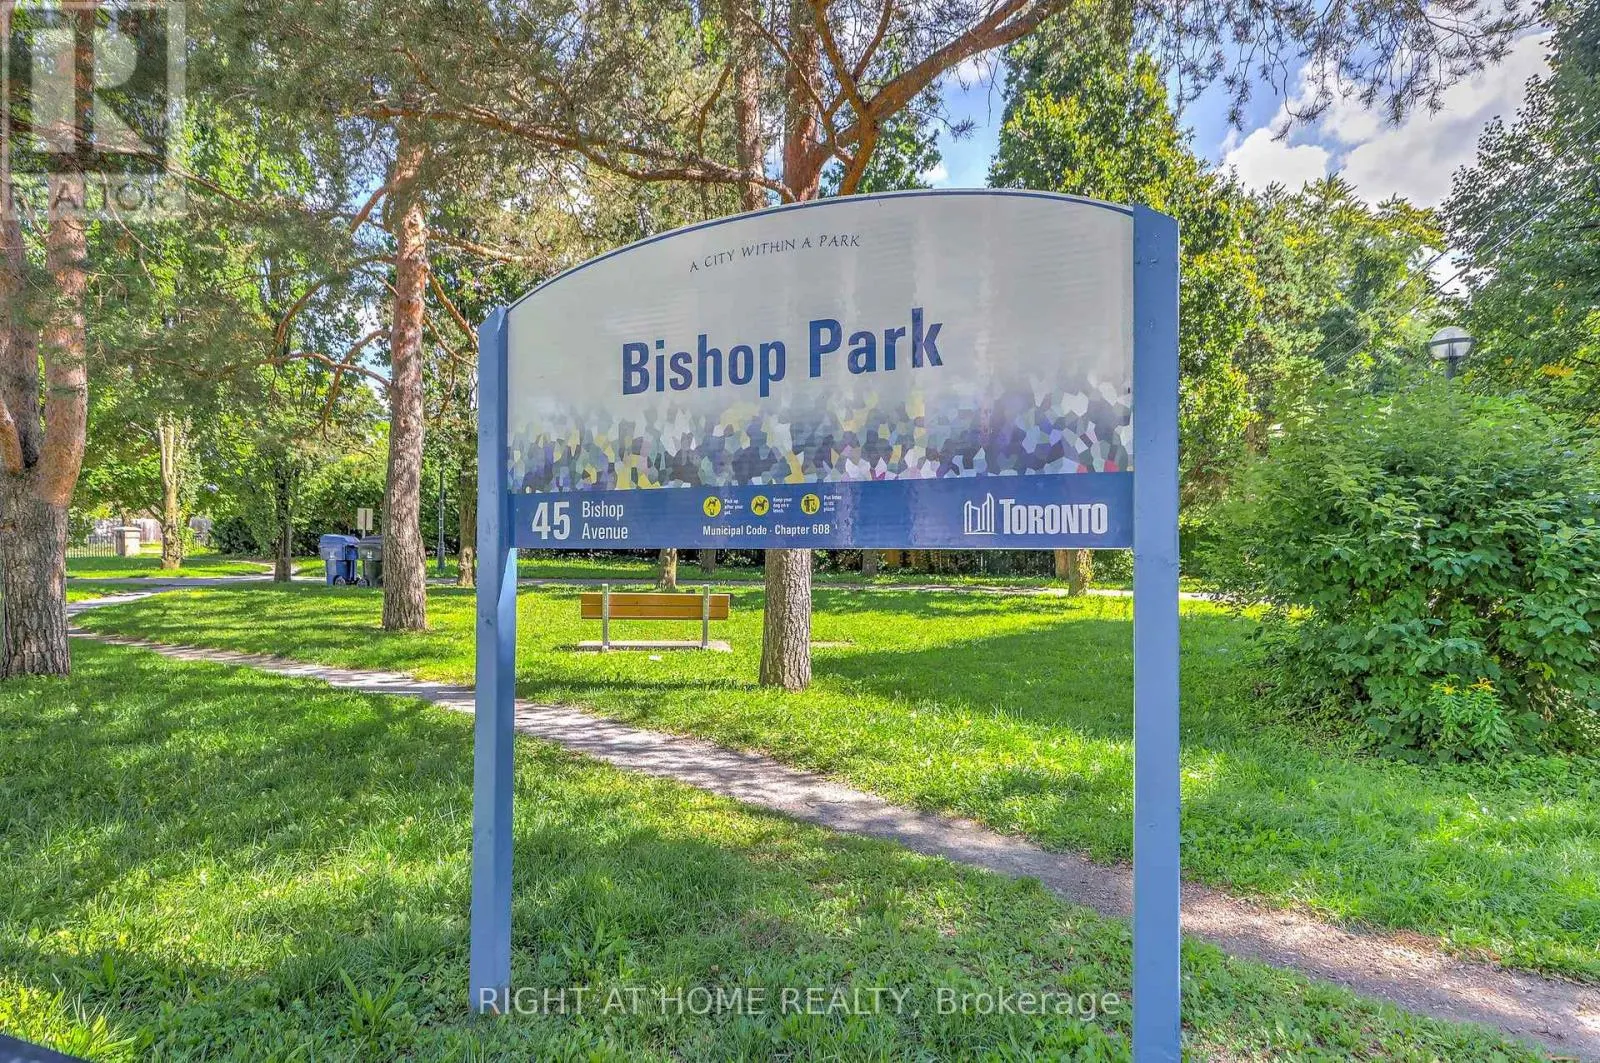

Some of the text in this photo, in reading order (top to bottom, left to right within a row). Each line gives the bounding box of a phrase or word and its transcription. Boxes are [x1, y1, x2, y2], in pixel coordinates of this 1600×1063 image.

[689, 234, 861, 273] A CITY WITHIN A PARK
[622, 307, 943, 398] Bishop Park
[531, 501, 571, 540] 45
[582, 500, 624, 520] Bishop
[999, 498, 1108, 535] TORONTO
[581, 522, 628, 540] Avenue
[703, 525, 744, 537] Municipal
[746, 525, 768, 535] Code
[774, 525, 810, 537] Chapter
[812, 524, 830, 535] 608
